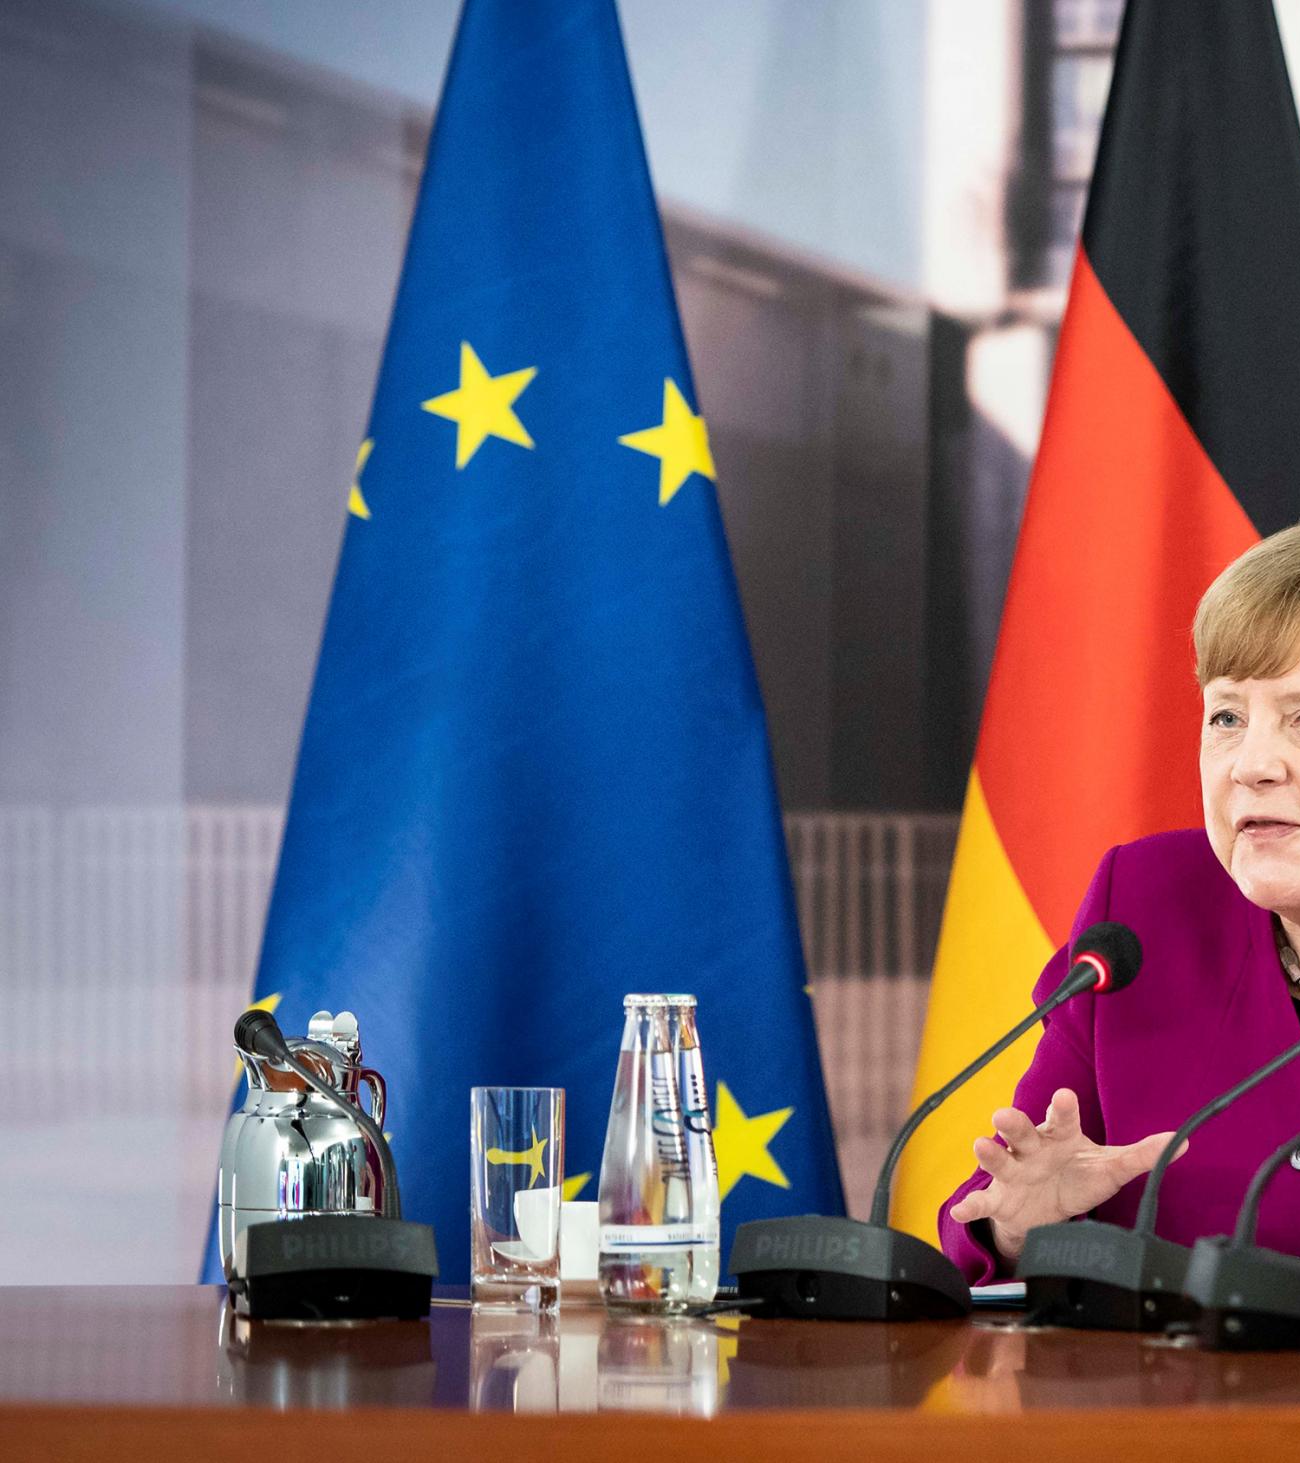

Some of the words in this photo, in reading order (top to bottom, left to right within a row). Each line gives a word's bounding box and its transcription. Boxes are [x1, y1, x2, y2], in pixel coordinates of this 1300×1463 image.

[282, 1233, 409, 1260] PHILIPS
[755, 1233, 861, 1262] PHILIPS
[1034, 1239, 1117, 1271] PHILIPS
